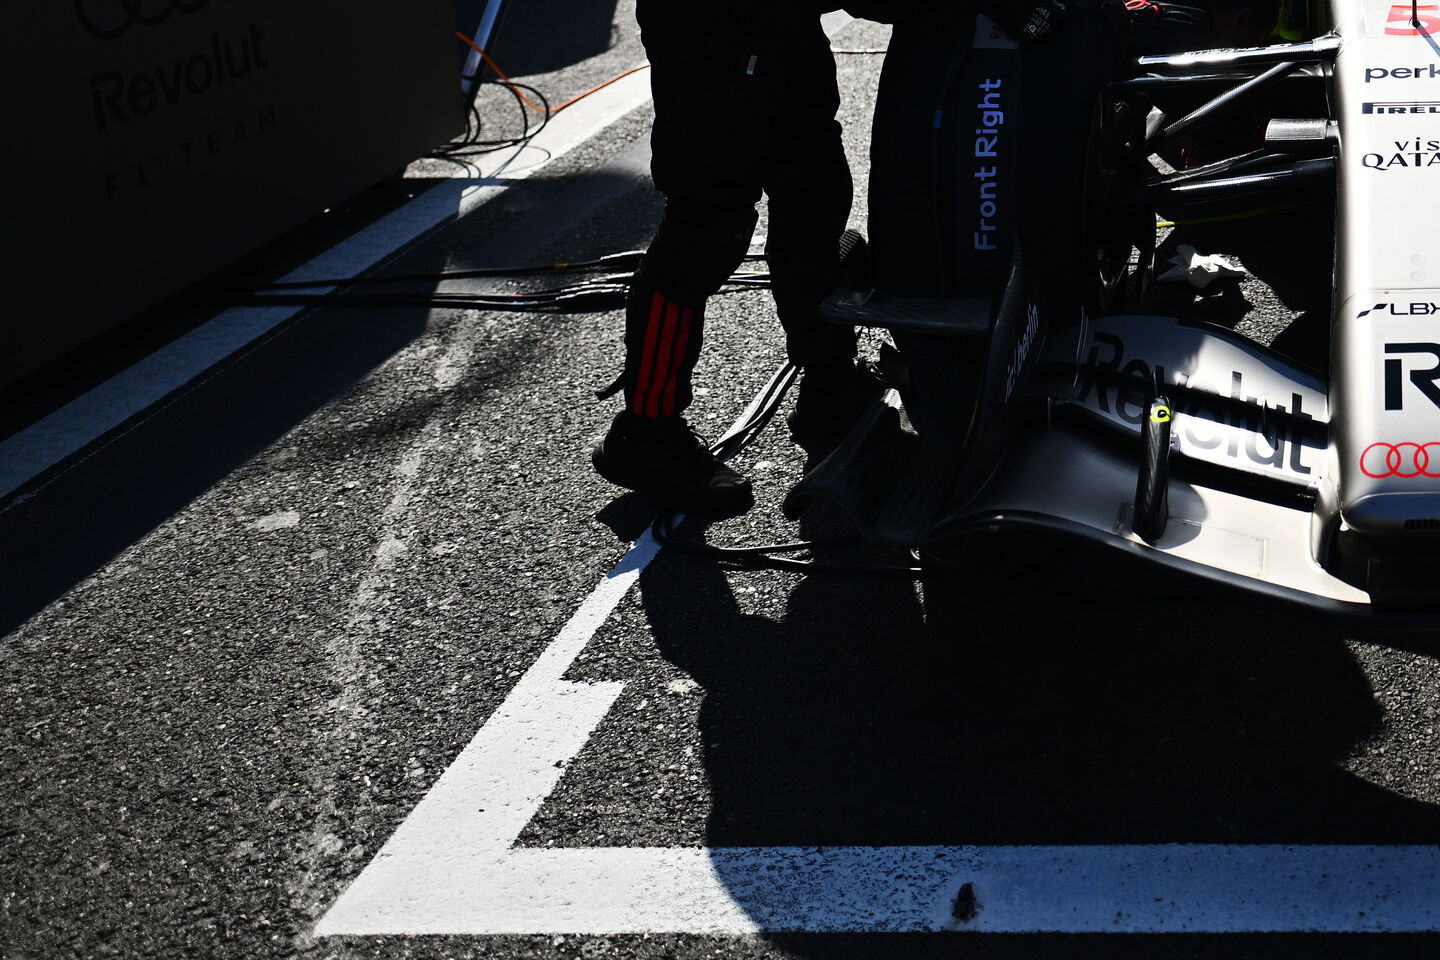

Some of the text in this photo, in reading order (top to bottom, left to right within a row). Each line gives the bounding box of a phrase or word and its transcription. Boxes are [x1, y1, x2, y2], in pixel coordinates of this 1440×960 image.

[89, 23, 268, 134] Revolut
[181, 106, 276, 165] TEAM
[974, 77, 1004, 252] Front Right
